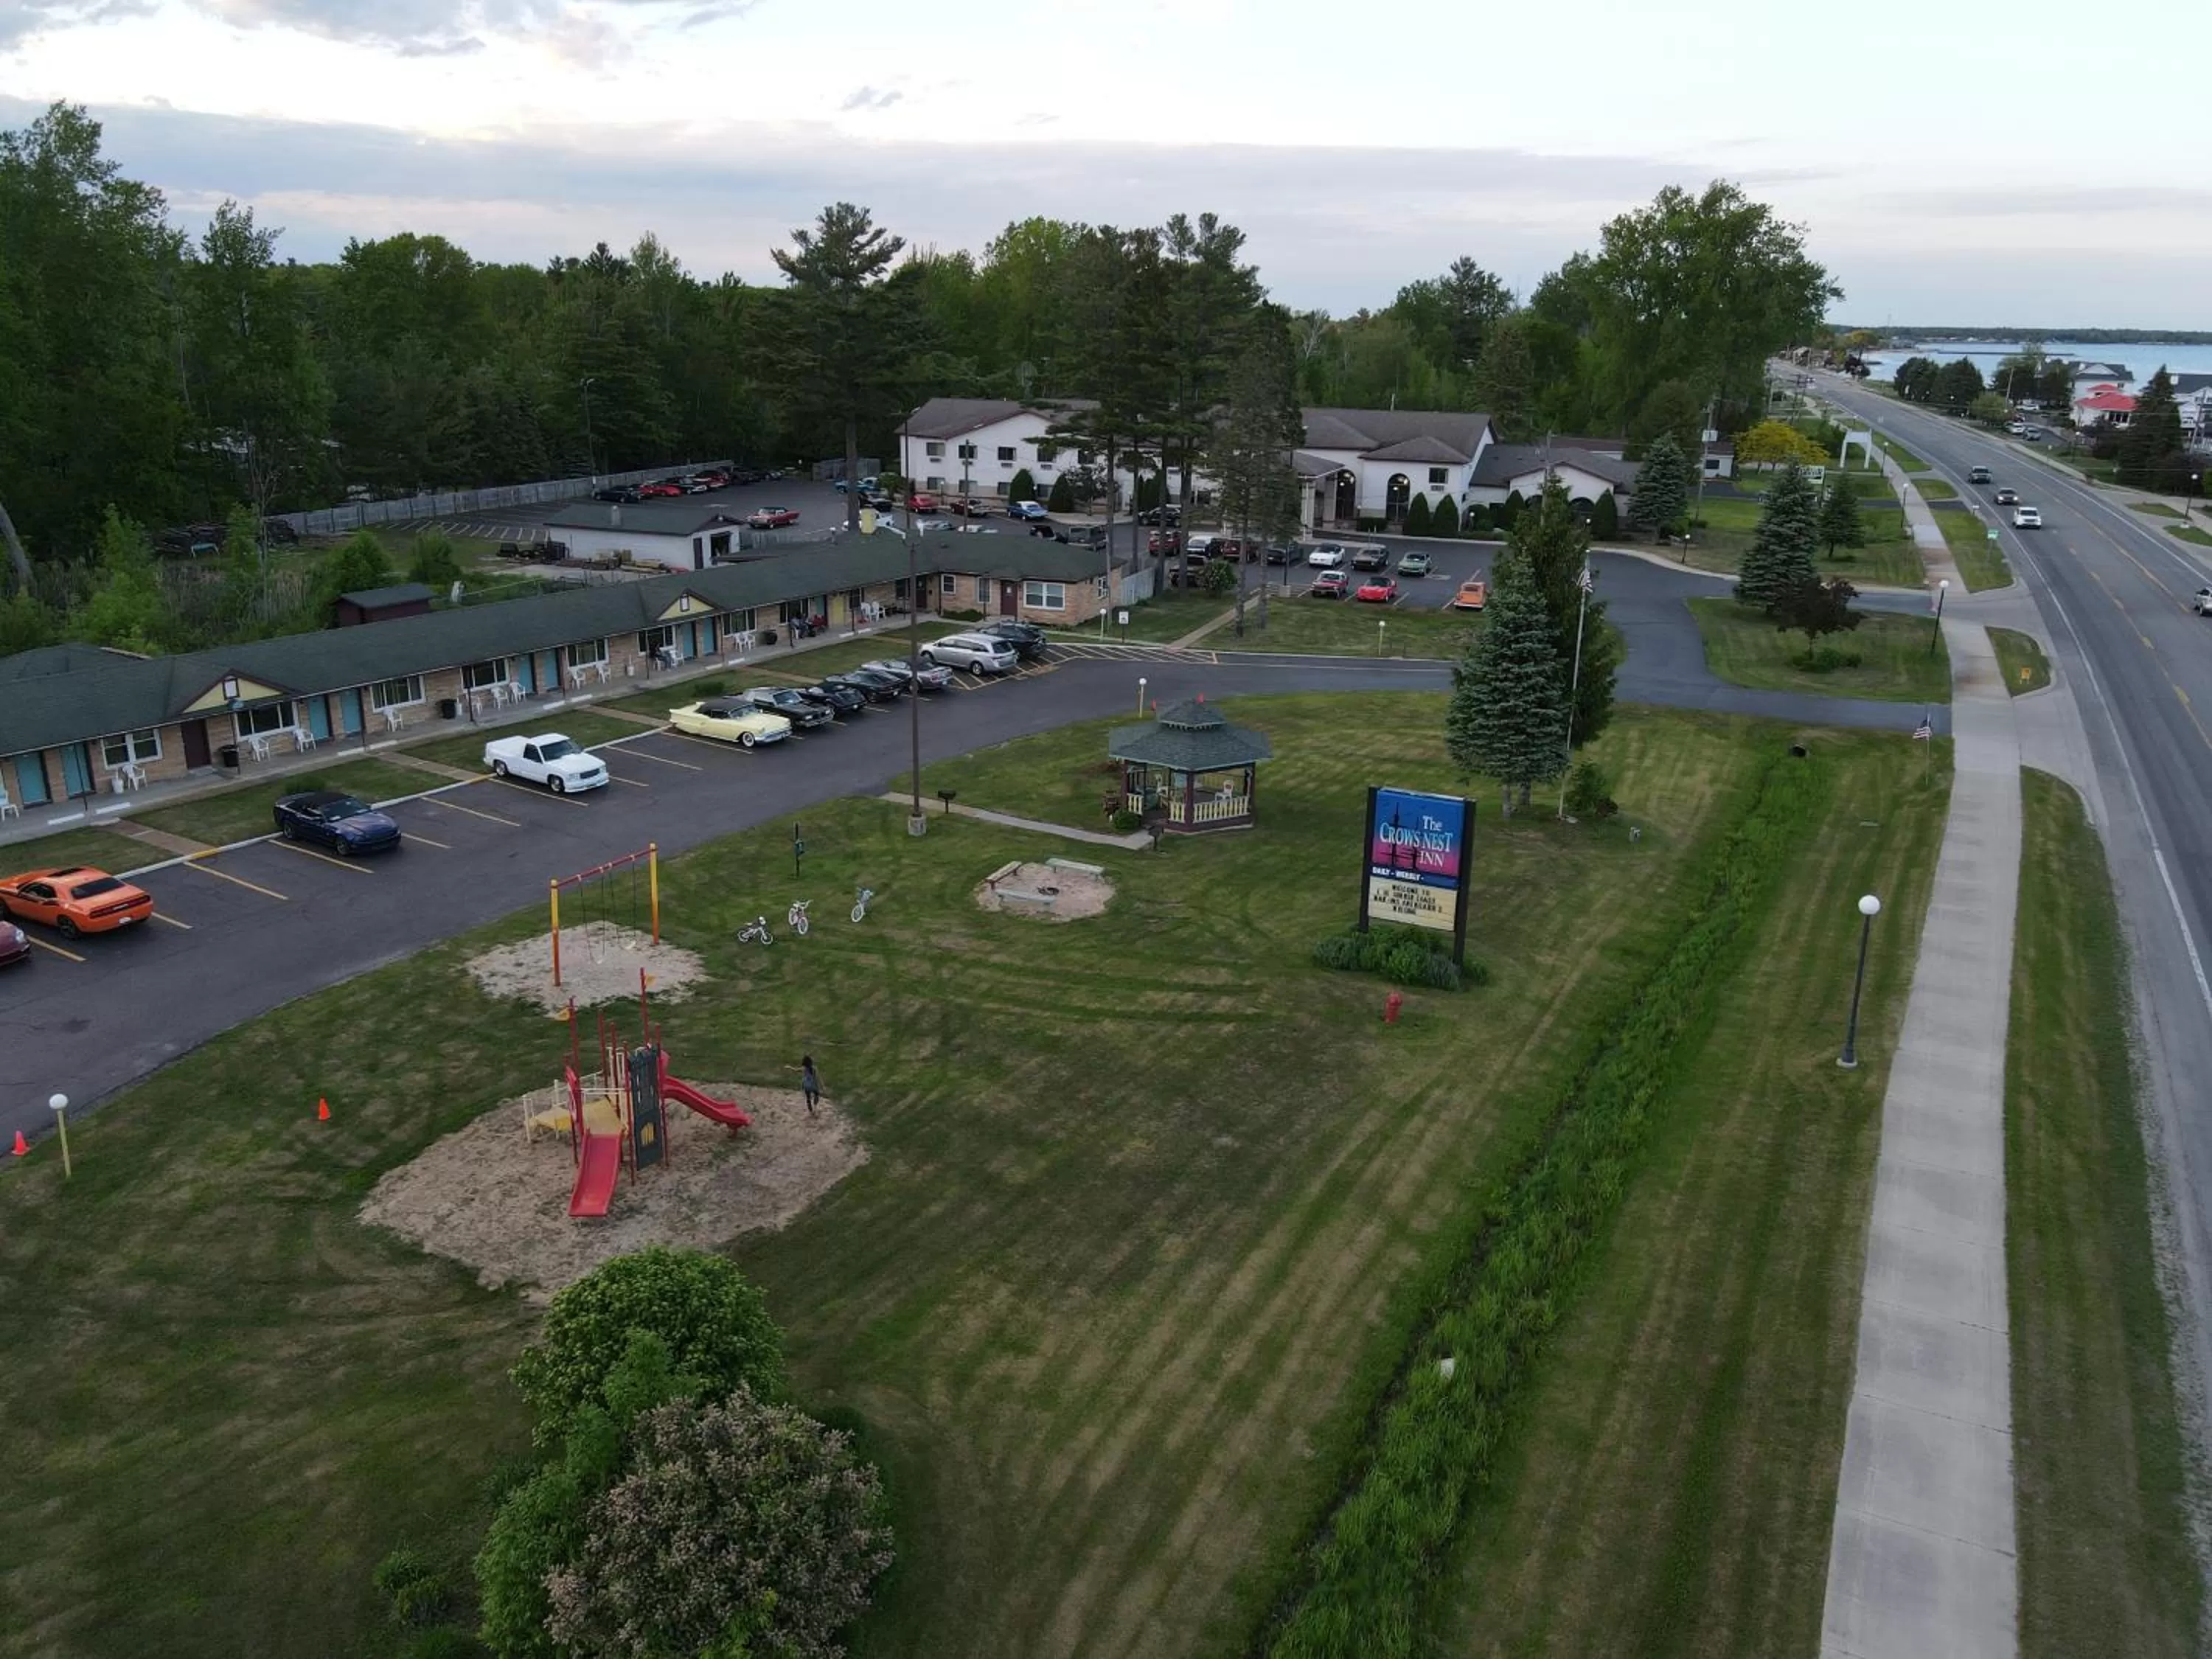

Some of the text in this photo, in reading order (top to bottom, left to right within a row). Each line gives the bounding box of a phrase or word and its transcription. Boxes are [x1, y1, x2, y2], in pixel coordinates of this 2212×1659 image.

[1422, 815, 1443, 832] The
[1422, 832, 1453, 853] NEST
[1419, 850, 1444, 867] INN
[1372, 866, 1420, 881] DAILY WEEKLY
